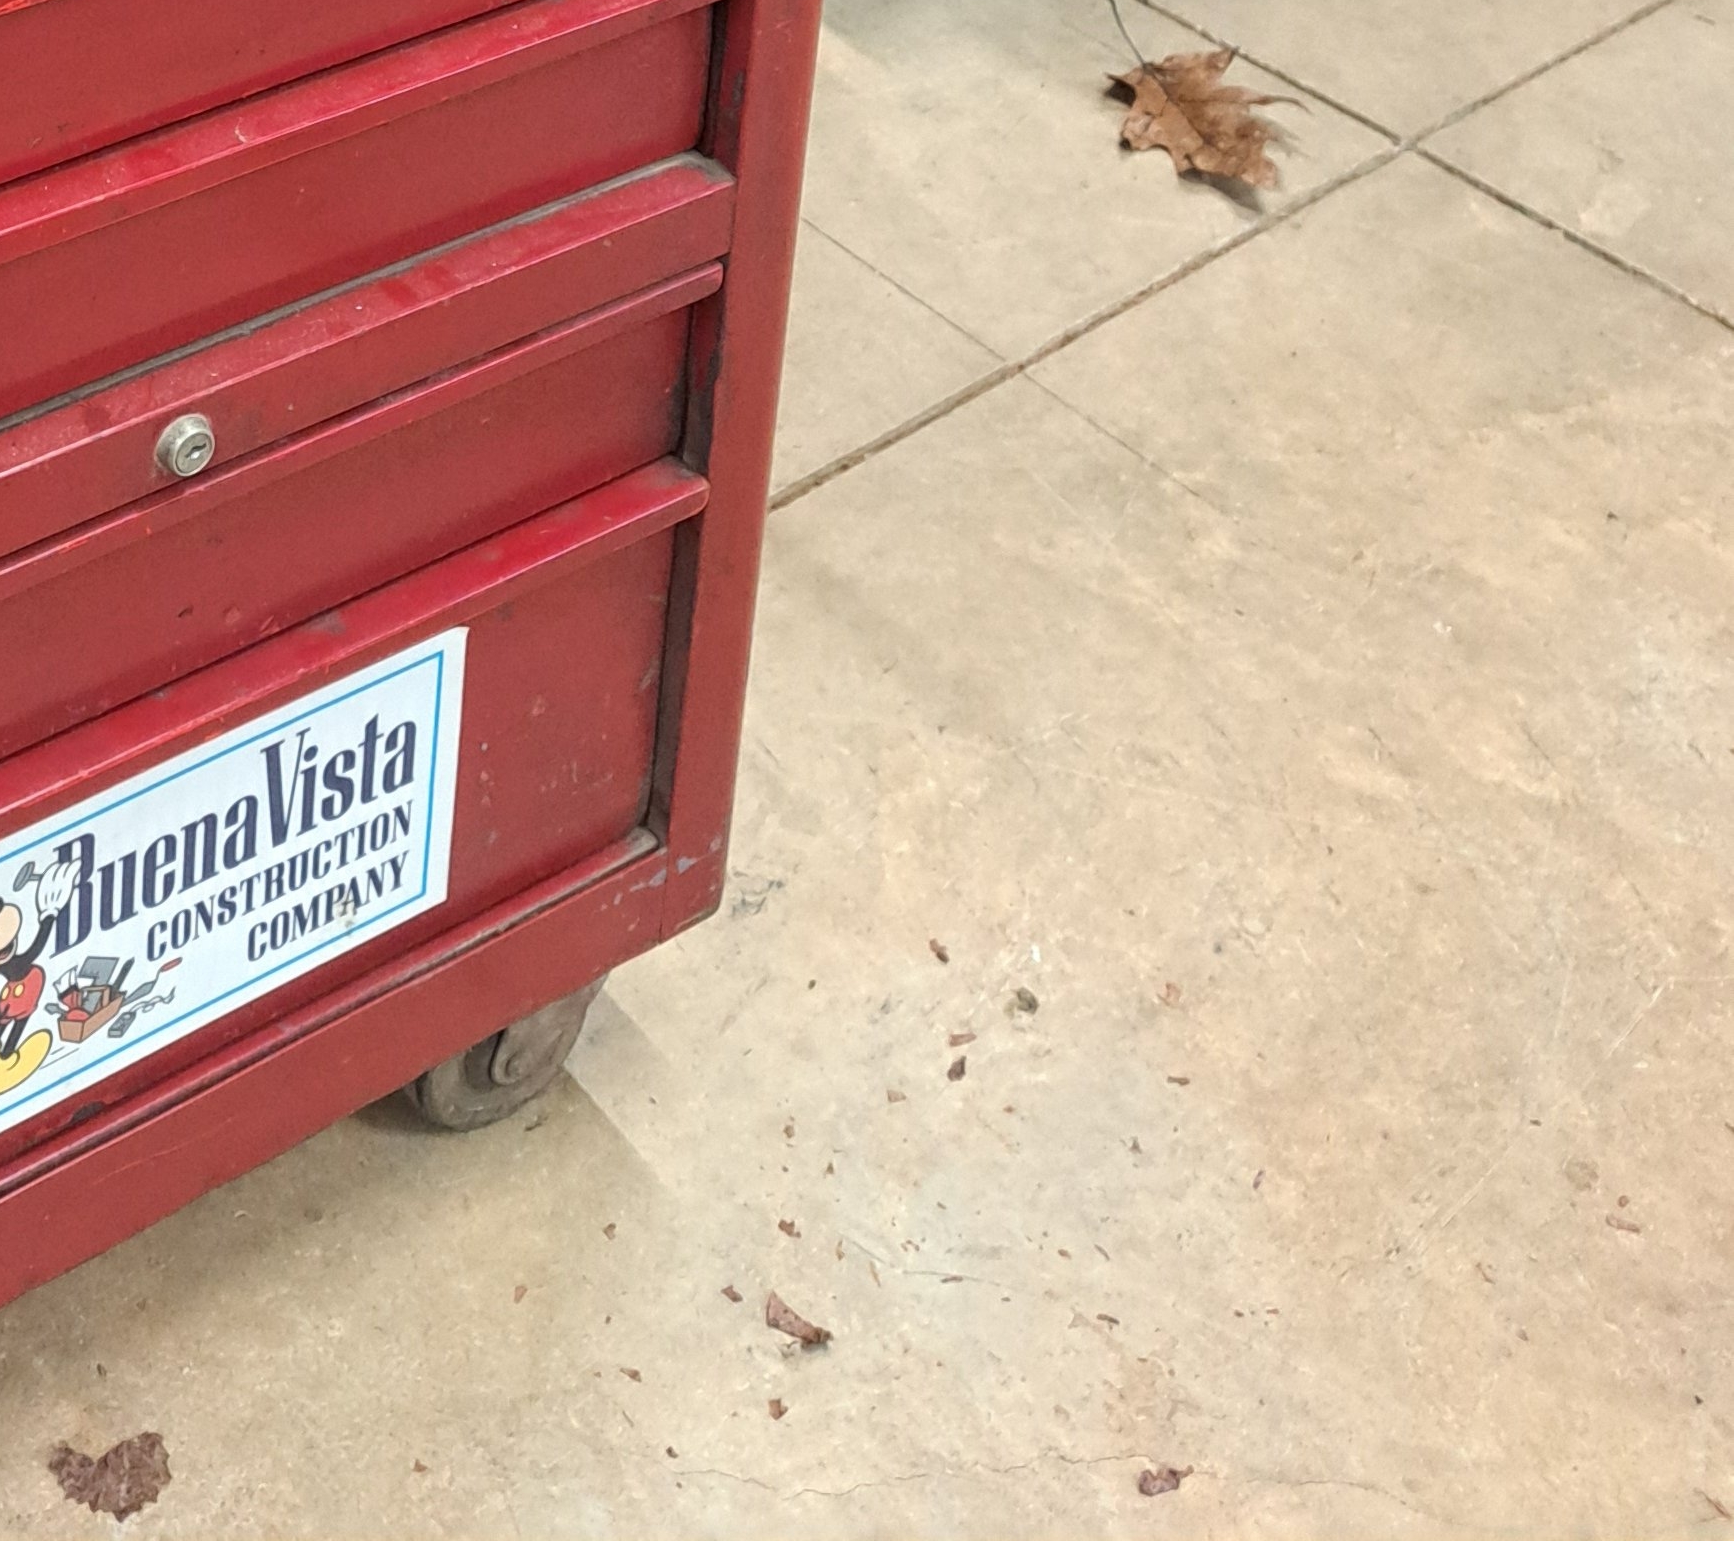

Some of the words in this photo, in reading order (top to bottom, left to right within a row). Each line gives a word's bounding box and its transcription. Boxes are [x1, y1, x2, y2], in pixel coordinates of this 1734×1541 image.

[48, 794, 260, 960] Buena
[260, 713, 417, 848] Vista
[146, 799, 415, 962] CONSTRUCTION
[247, 850, 410, 962] COMPANY
